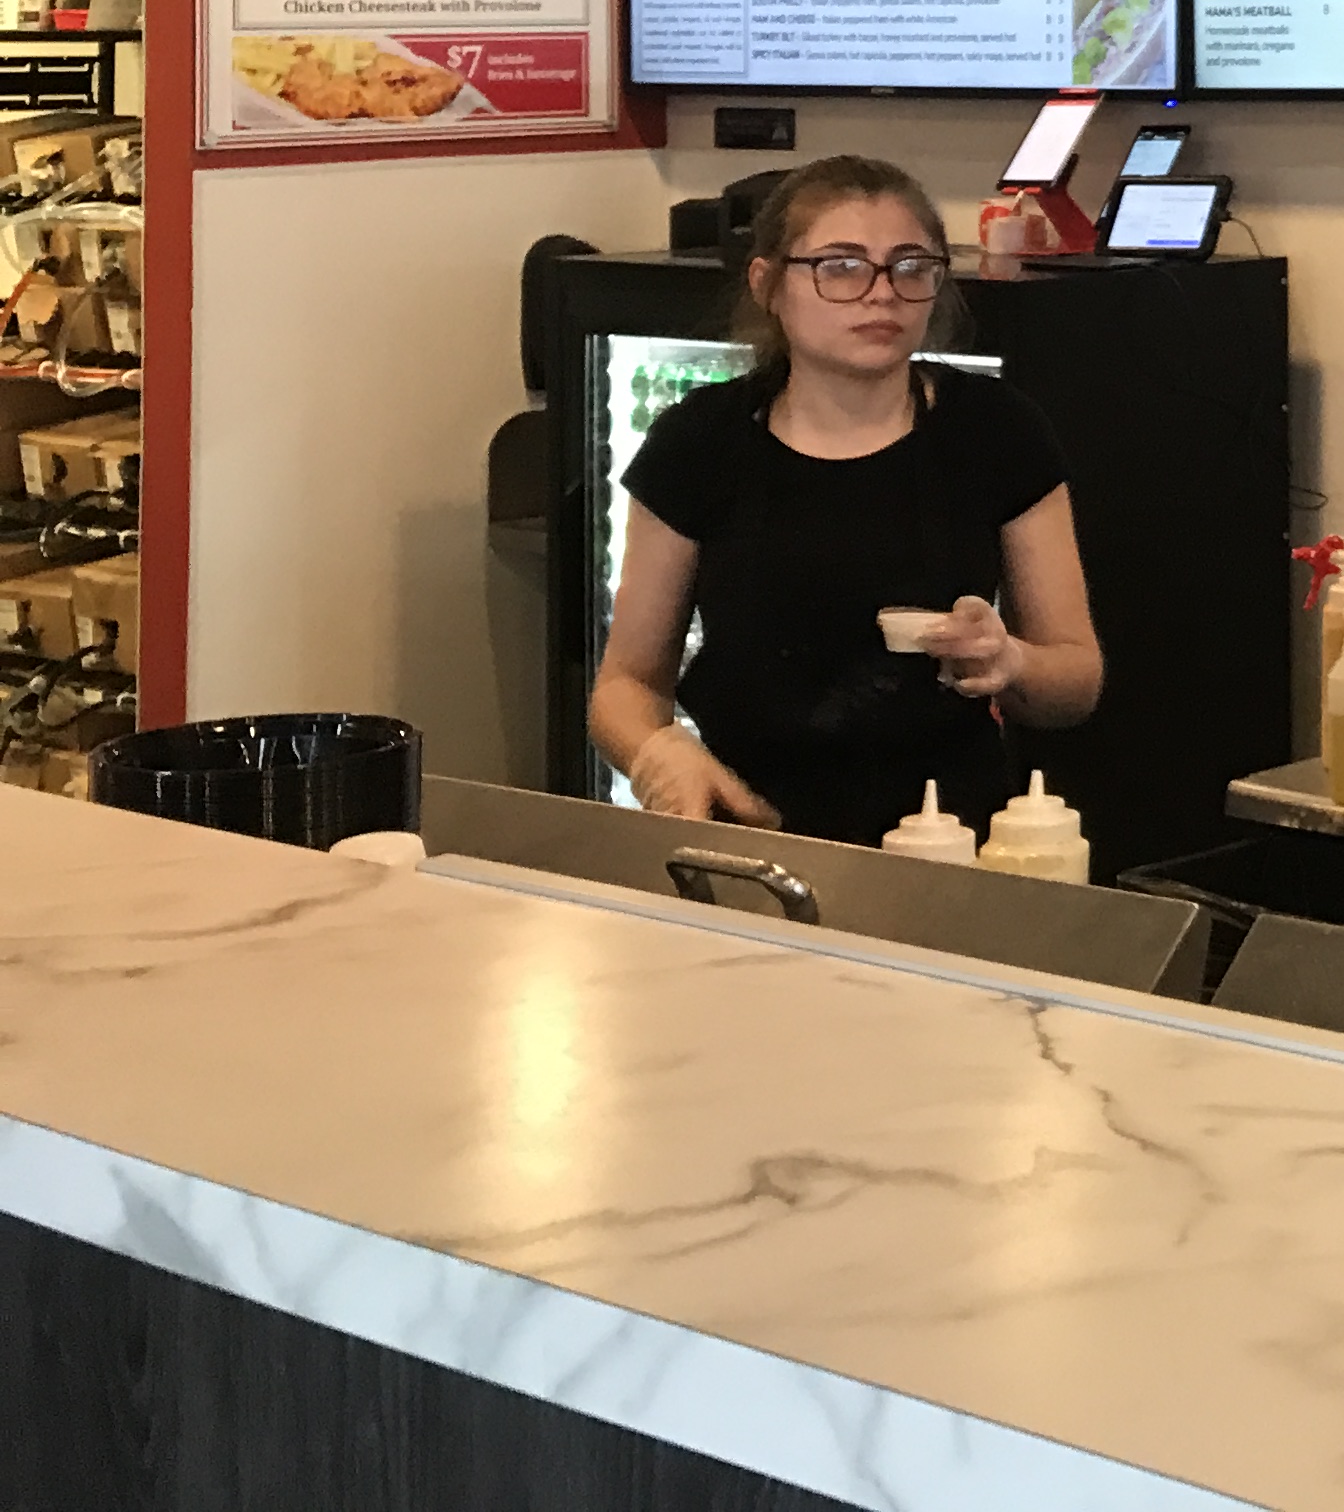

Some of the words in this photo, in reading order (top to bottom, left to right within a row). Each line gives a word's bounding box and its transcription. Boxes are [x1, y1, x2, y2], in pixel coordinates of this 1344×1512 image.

[283, 0, 345, 14] Chicken
[348, 0, 437, 13] Cheesesteak
[440, 0, 471, 12] with
[474, 0, 542, 13] Provolone
[1205, 6, 1241, 17] MAMA'S
[1243, 5, 1292, 17] MEATBALL
[446, 44, 484, 79] $7
